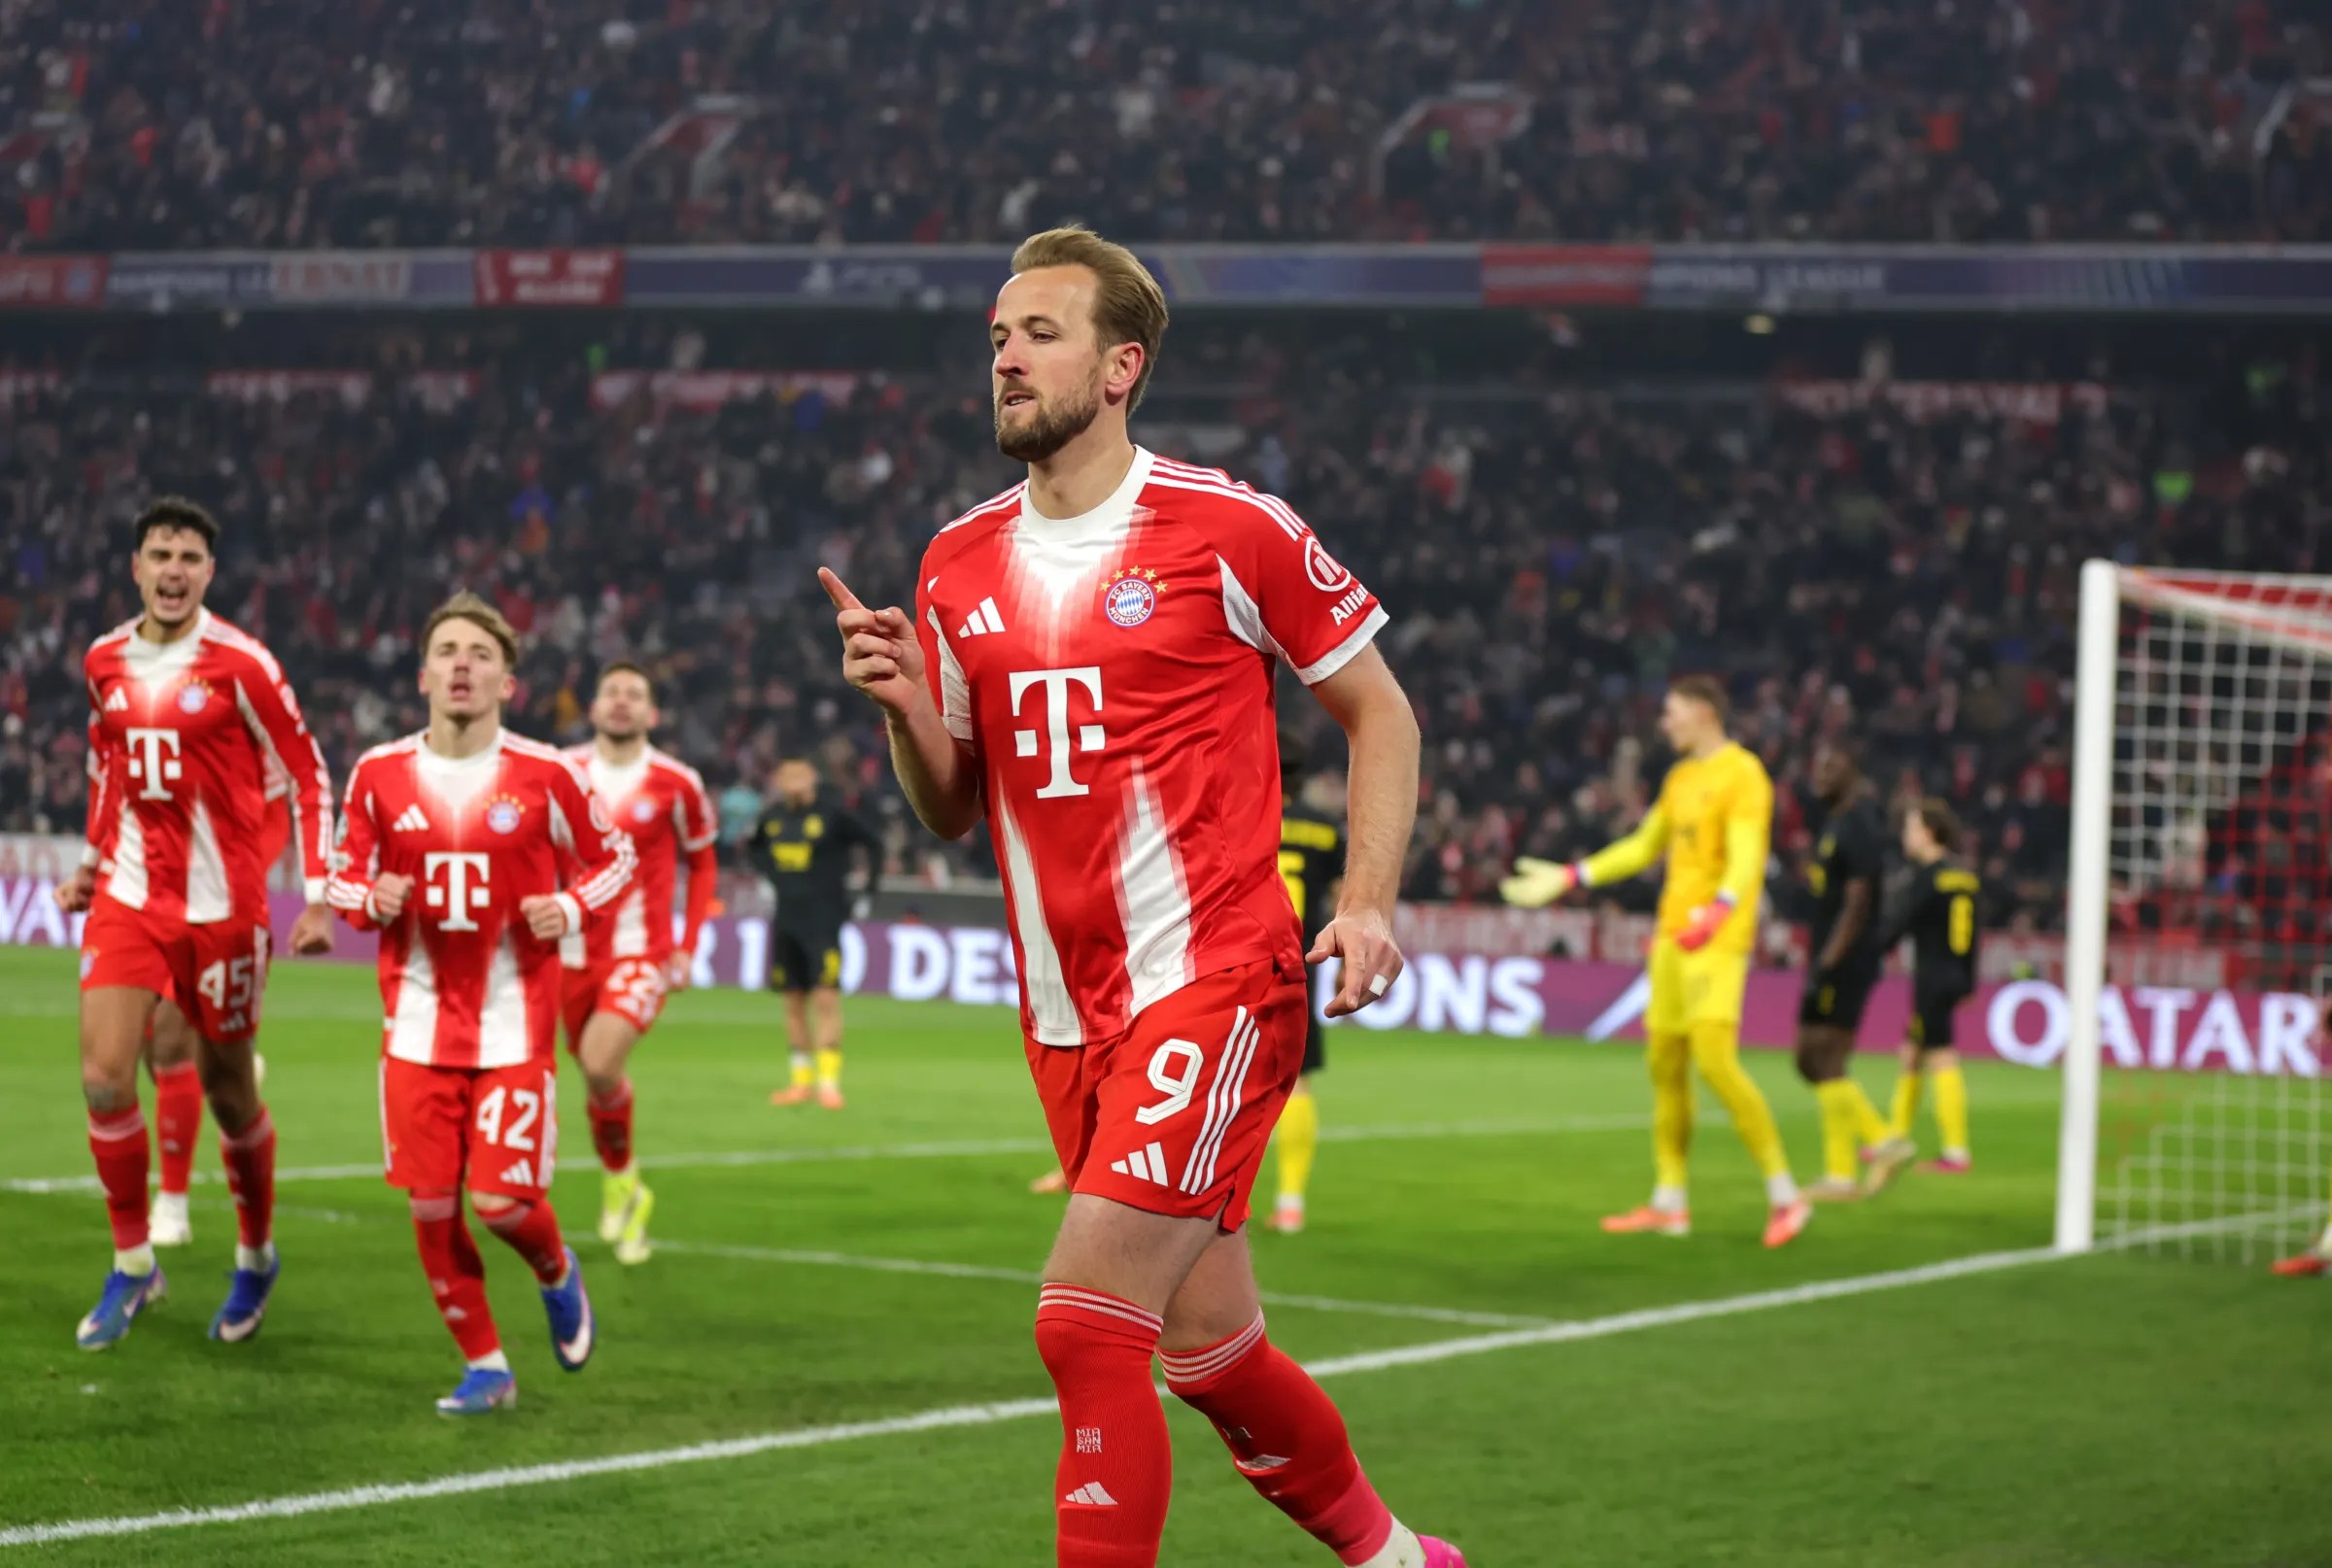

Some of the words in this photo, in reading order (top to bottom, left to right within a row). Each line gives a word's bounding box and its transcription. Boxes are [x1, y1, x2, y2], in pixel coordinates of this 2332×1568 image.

[1111, 589, 1121, 599] FC
[1120, 582, 1150, 600] BAYERN
[1009, 666, 1105, 799] T
[126, 728, 182, 801] T
[425, 852, 490, 931] T
[198, 955, 254, 1010] 45
[1134, 1038, 1204, 1126] 9
[476, 1084, 539, 1152] 42
[1076, 1427, 1101, 1438] MIA
[1077, 1436, 1101, 1446] SAN
[1077, 1444, 1103, 1453] MIA
